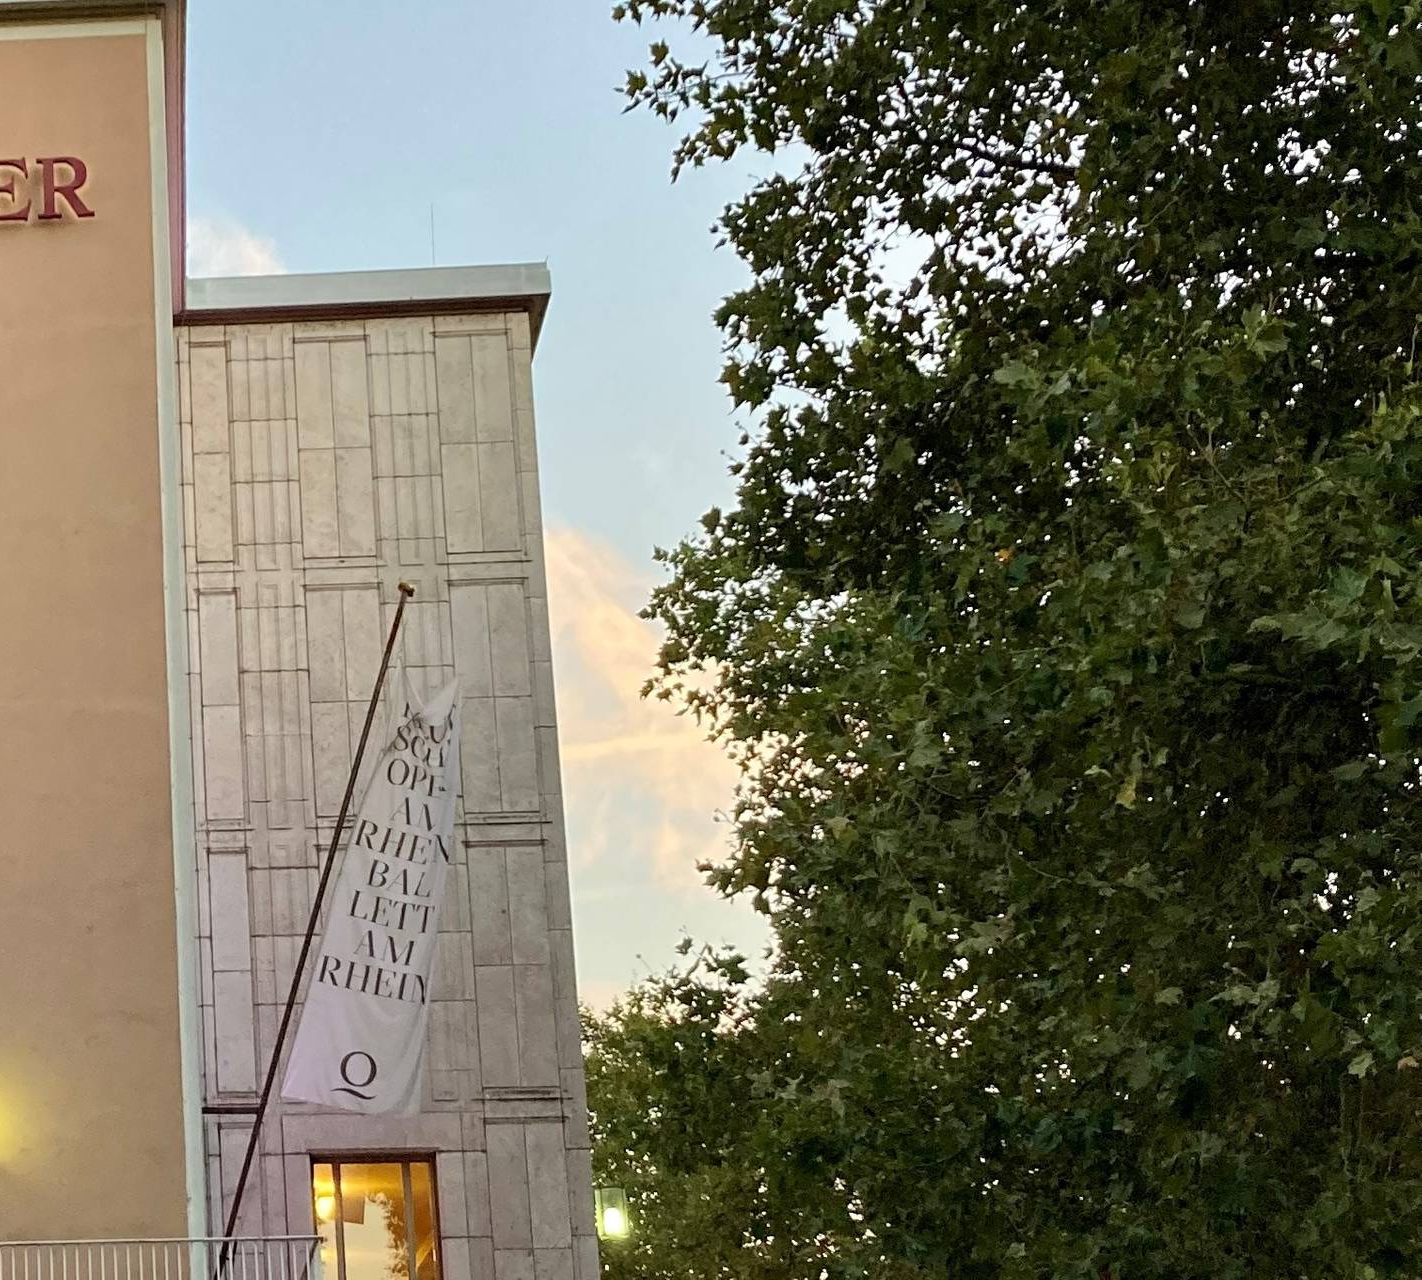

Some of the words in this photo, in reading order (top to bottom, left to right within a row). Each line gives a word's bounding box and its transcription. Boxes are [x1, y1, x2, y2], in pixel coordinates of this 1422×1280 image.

[367, 859, 432, 898] BAL
[347, 889, 435, 934] LETT
[353, 929, 415, 967] AM
[318, 954, 427, 1006] RHEIN
